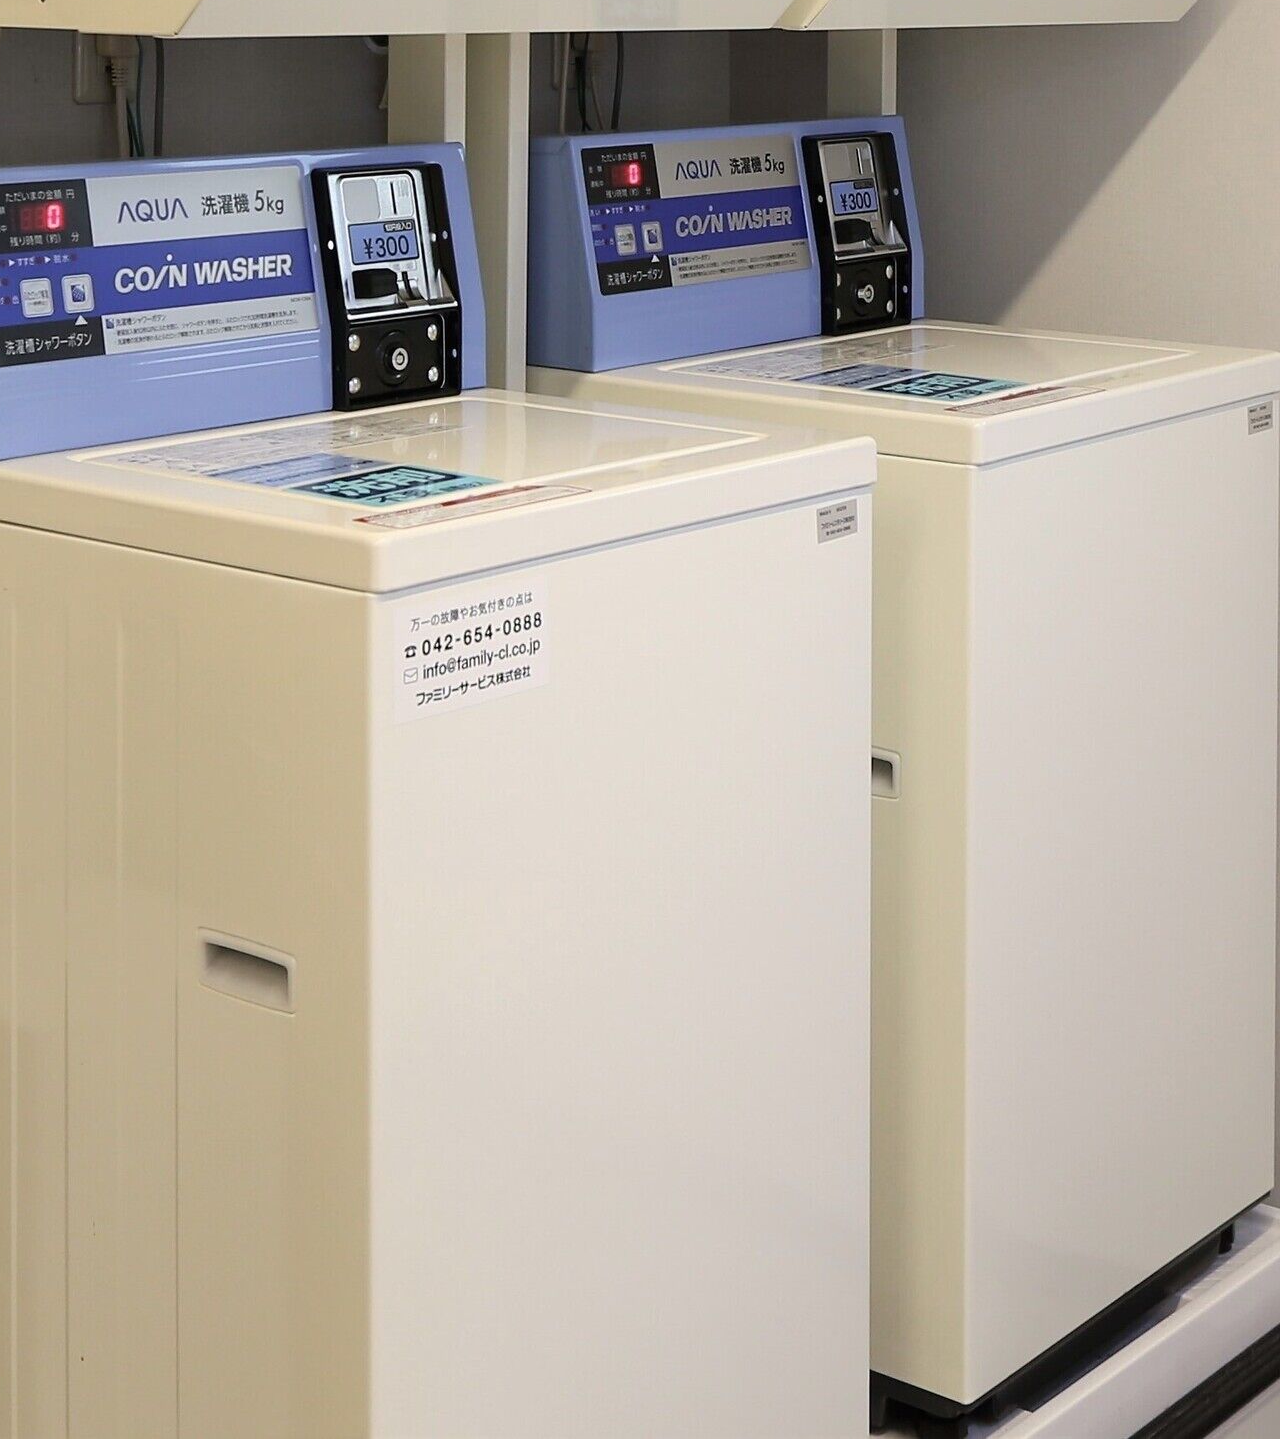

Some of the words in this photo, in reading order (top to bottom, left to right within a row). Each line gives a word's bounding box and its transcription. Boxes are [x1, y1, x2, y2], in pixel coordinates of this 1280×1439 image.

[629, 164, 639, 184] 0
[675, 159, 723, 181] AQUA
[729, 156, 762, 175] 洗濯機
[764, 153, 785, 175] 5kg
[5, 189, 62, 202] ただいまの金額
[66, 188, 75, 199] 円
[201, 193, 250, 217] 洗濯機
[254, 189, 285, 215] 5kg
[840, 191, 872, 211] ¥300
[47, 204, 61, 229] 0
[117, 197, 189, 224] AQUA
[675, 205, 724, 238] COIN
[727, 206, 793, 232] WASHER
[71, 232, 80, 242] 分
[363, 234, 410, 260] ¥300
[114, 253, 188, 294] COIN
[193, 253, 293, 286] WASHER
[5, 332, 93, 356] 洗濯槽シャワーボタン
[312, 467, 447, 495] 洗剤
[410, 591, 533, 633] 万一の故障やお気付きの点は
[421, 611, 542, 656] 042-654-0888
[422, 637, 541, 680] info@family-cl.co.jp
[415, 665, 531, 706] ファミリーサービス株式会社
